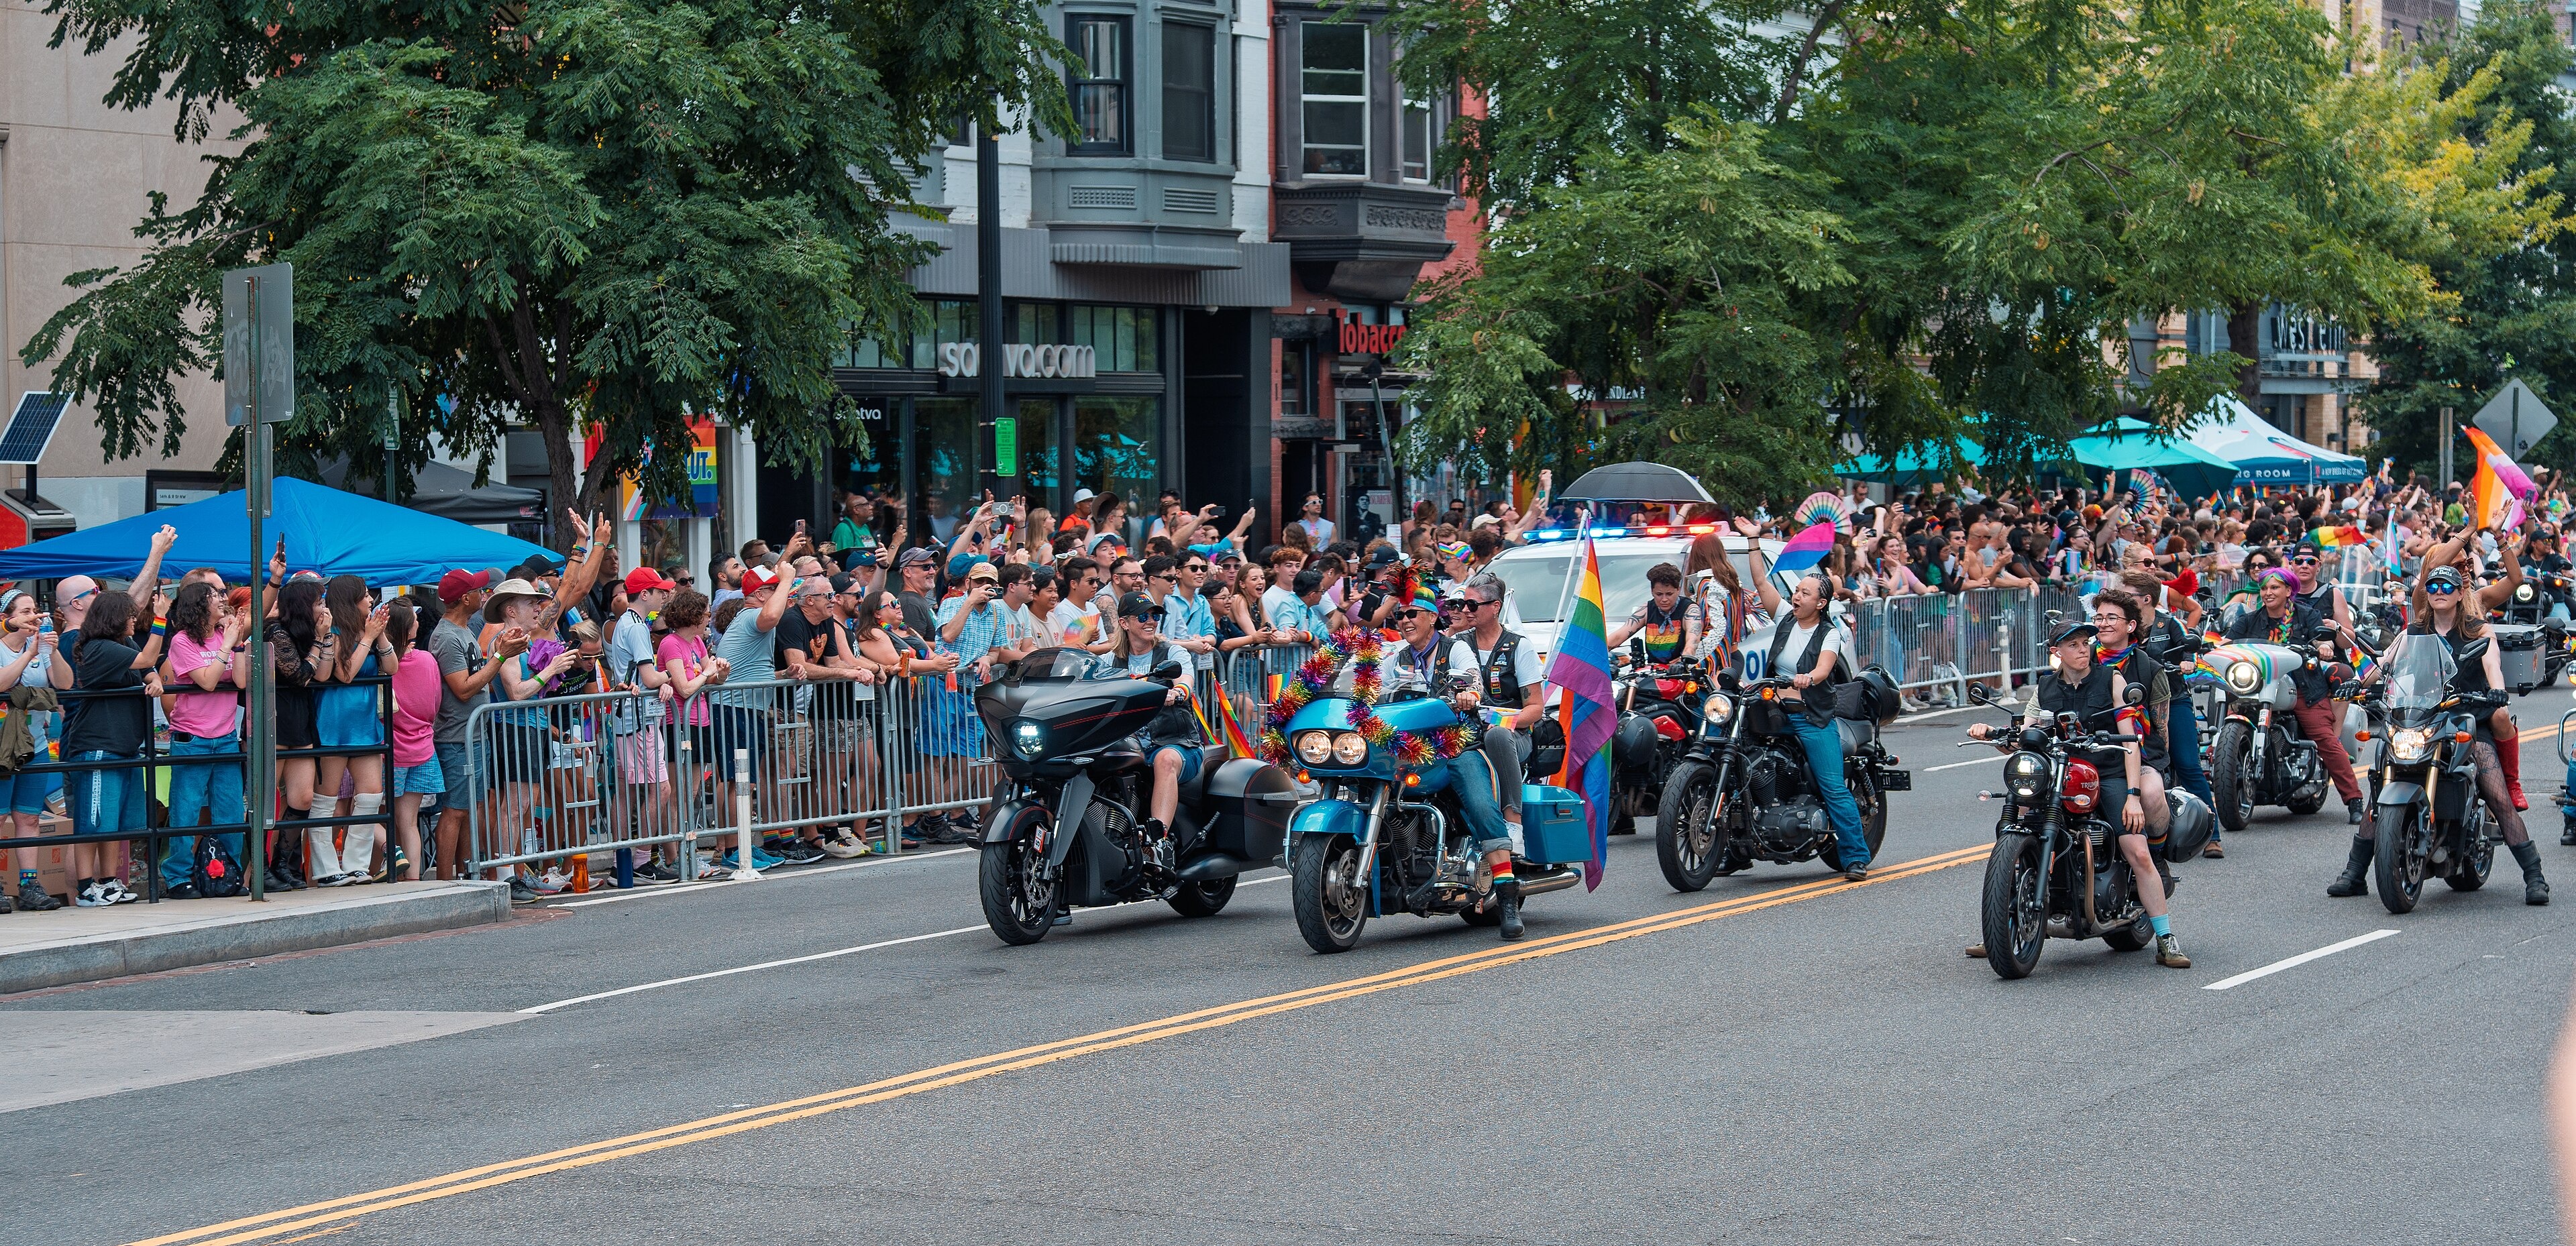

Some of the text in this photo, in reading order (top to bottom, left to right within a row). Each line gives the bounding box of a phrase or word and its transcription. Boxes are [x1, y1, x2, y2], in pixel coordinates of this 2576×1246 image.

[939, 341, 1096, 378] sava.com
[2255, 469, 2291, 478] ROOM
[2081, 781, 2098, 790] TRIUM
